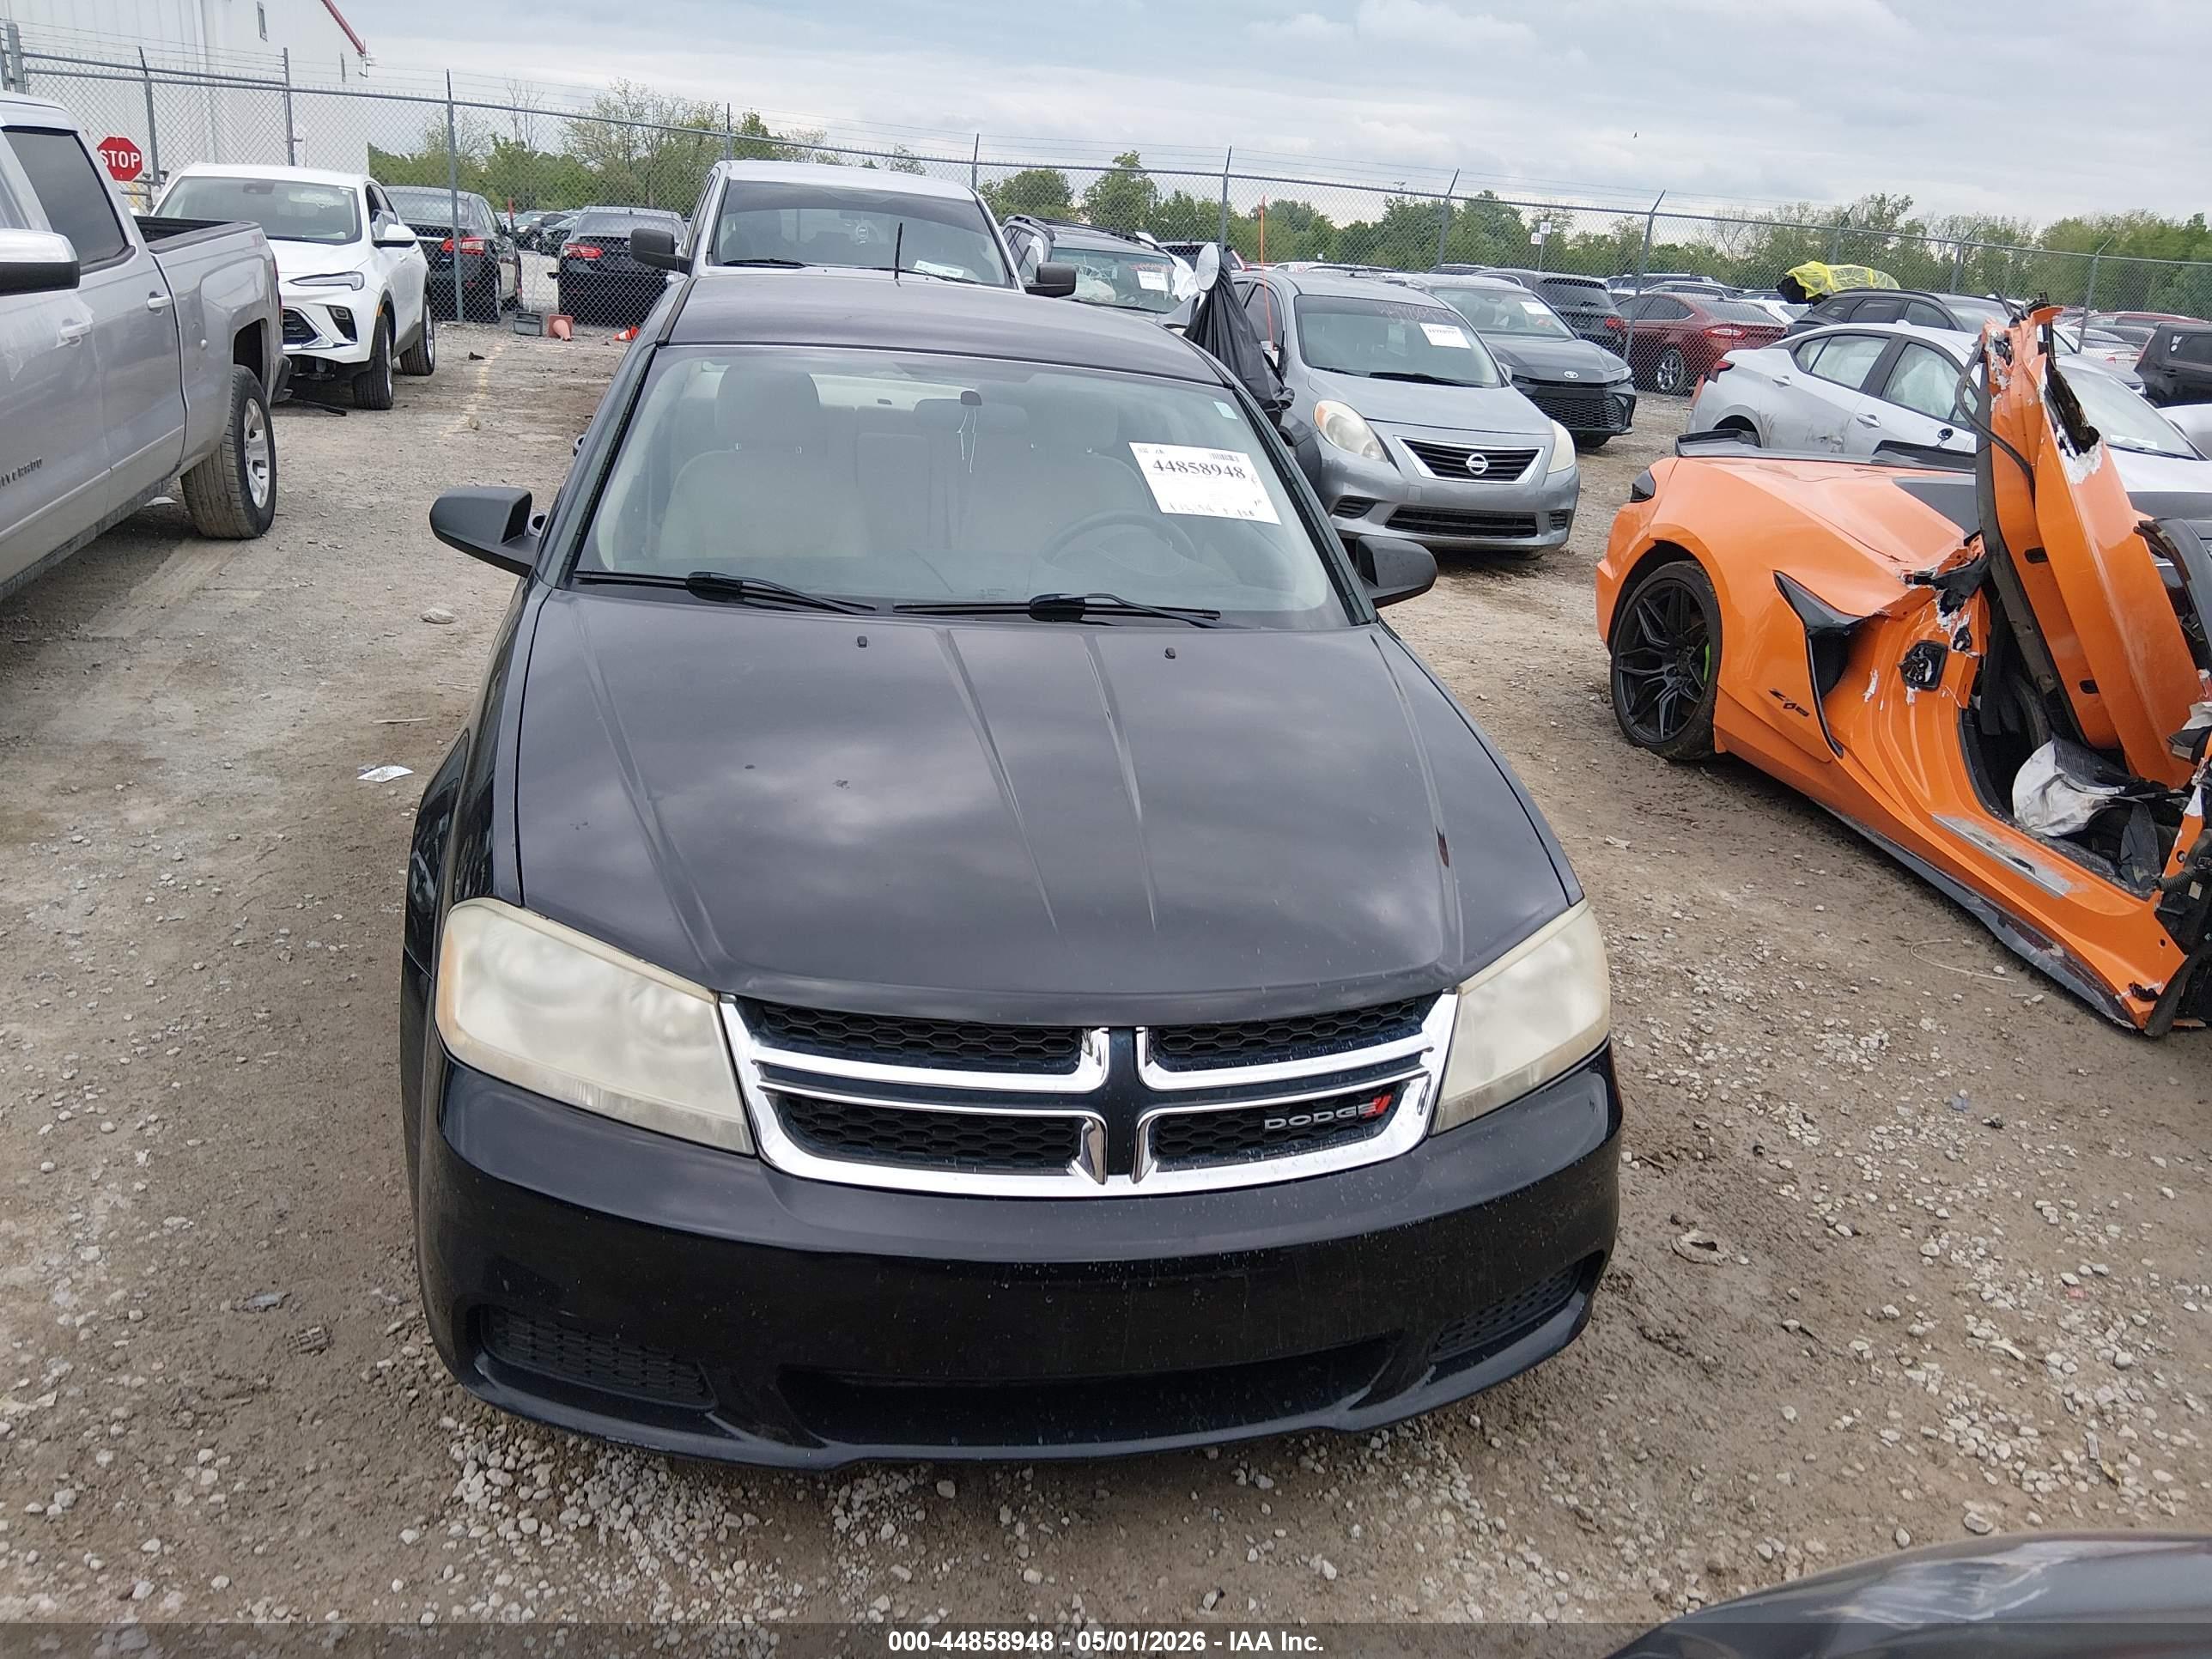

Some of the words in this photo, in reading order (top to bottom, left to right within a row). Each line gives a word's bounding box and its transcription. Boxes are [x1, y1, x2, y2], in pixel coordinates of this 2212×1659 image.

[99, 149, 140, 168] STOP
[1152, 459, 1246, 480] 44858948
[1264, 1103, 1376, 1130] DODGE
